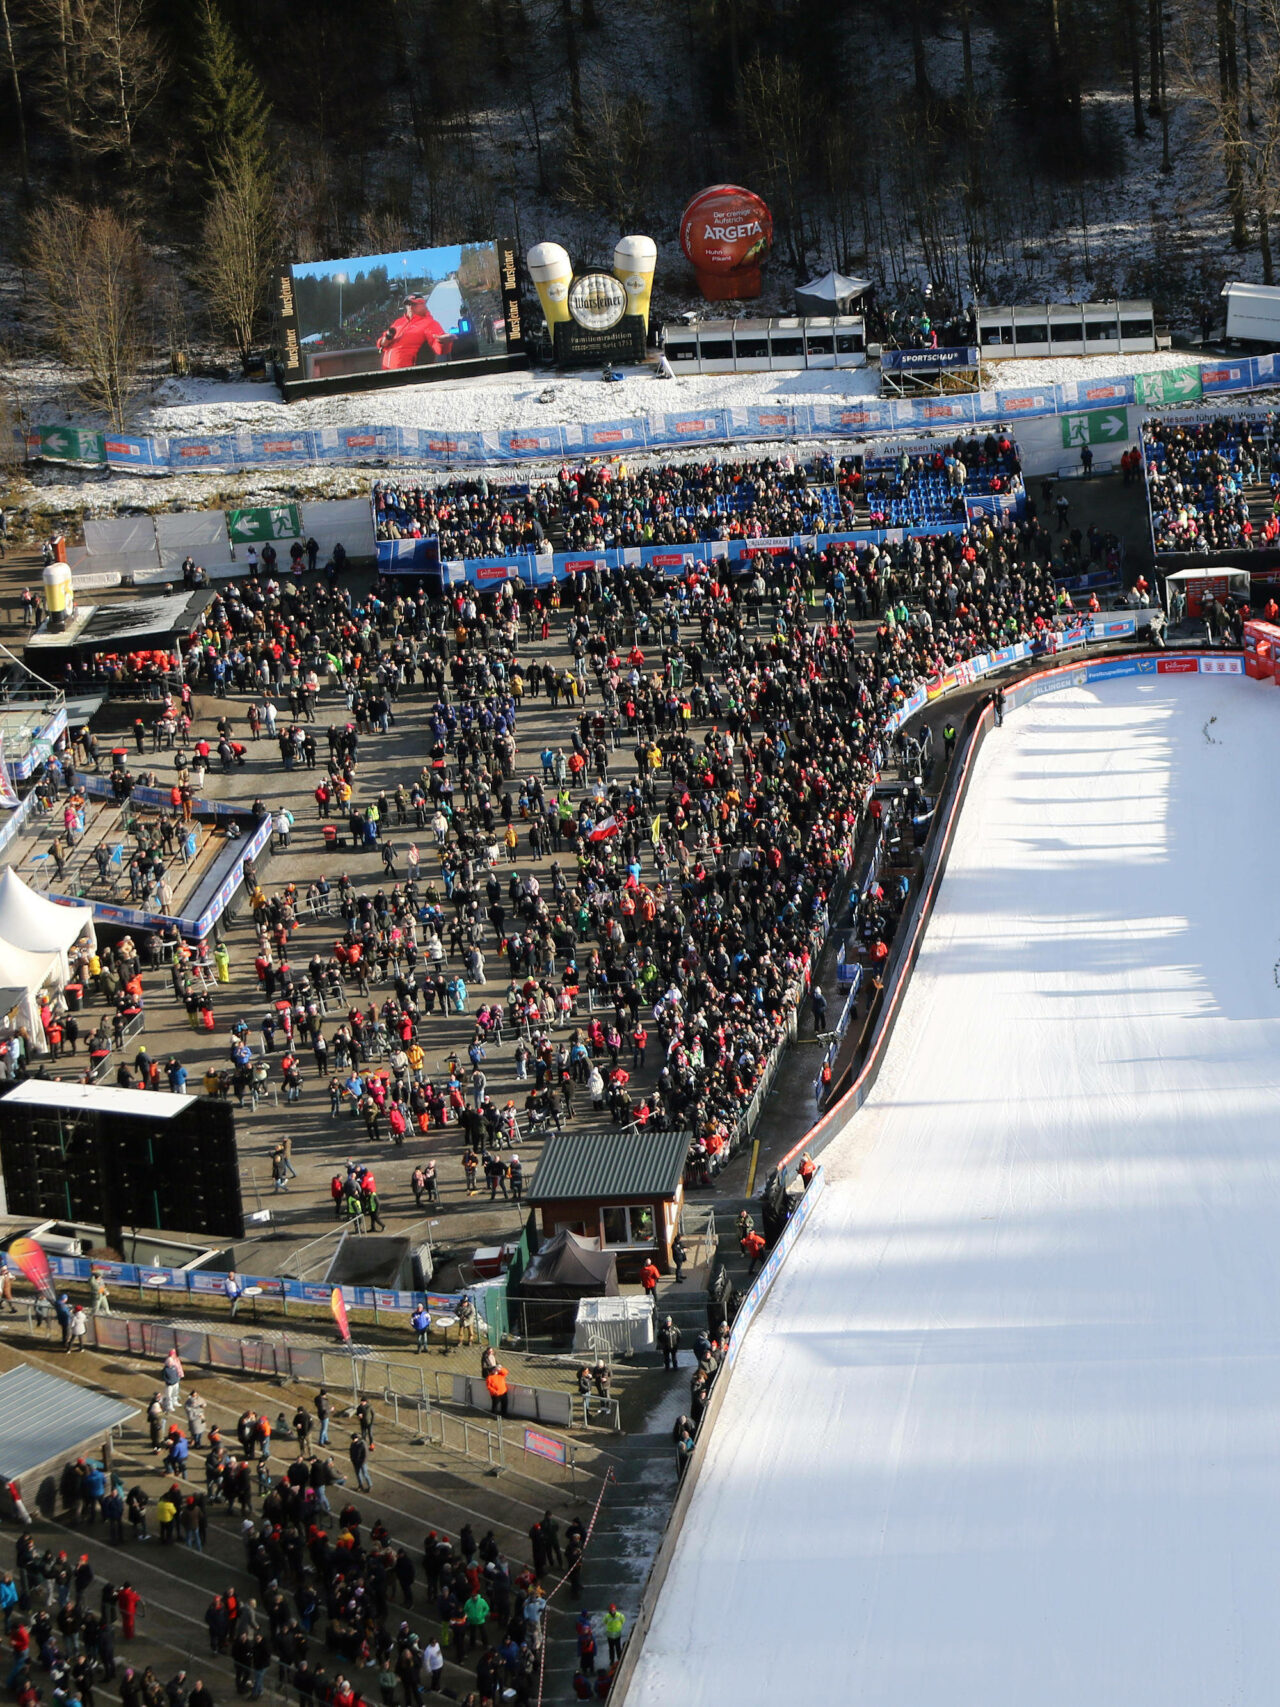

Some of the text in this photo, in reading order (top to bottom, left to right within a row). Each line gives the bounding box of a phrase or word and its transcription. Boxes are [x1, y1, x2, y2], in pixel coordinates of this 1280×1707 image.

[704, 220, 763, 243] ARGETA
[503, 249, 517, 291] Warsteiner
[279, 276, 293, 318] Warsteiner
[574, 296, 621, 310] Warsteiner
[507, 300, 522, 341] Warsteiner
[285, 328, 300, 370] Warsteiner
[1163, 414, 1195, 424] Hessen
[1196, 411, 1217, 422] führt
[883, 445, 896, 454] An
[897, 444, 929, 453] Hessen
